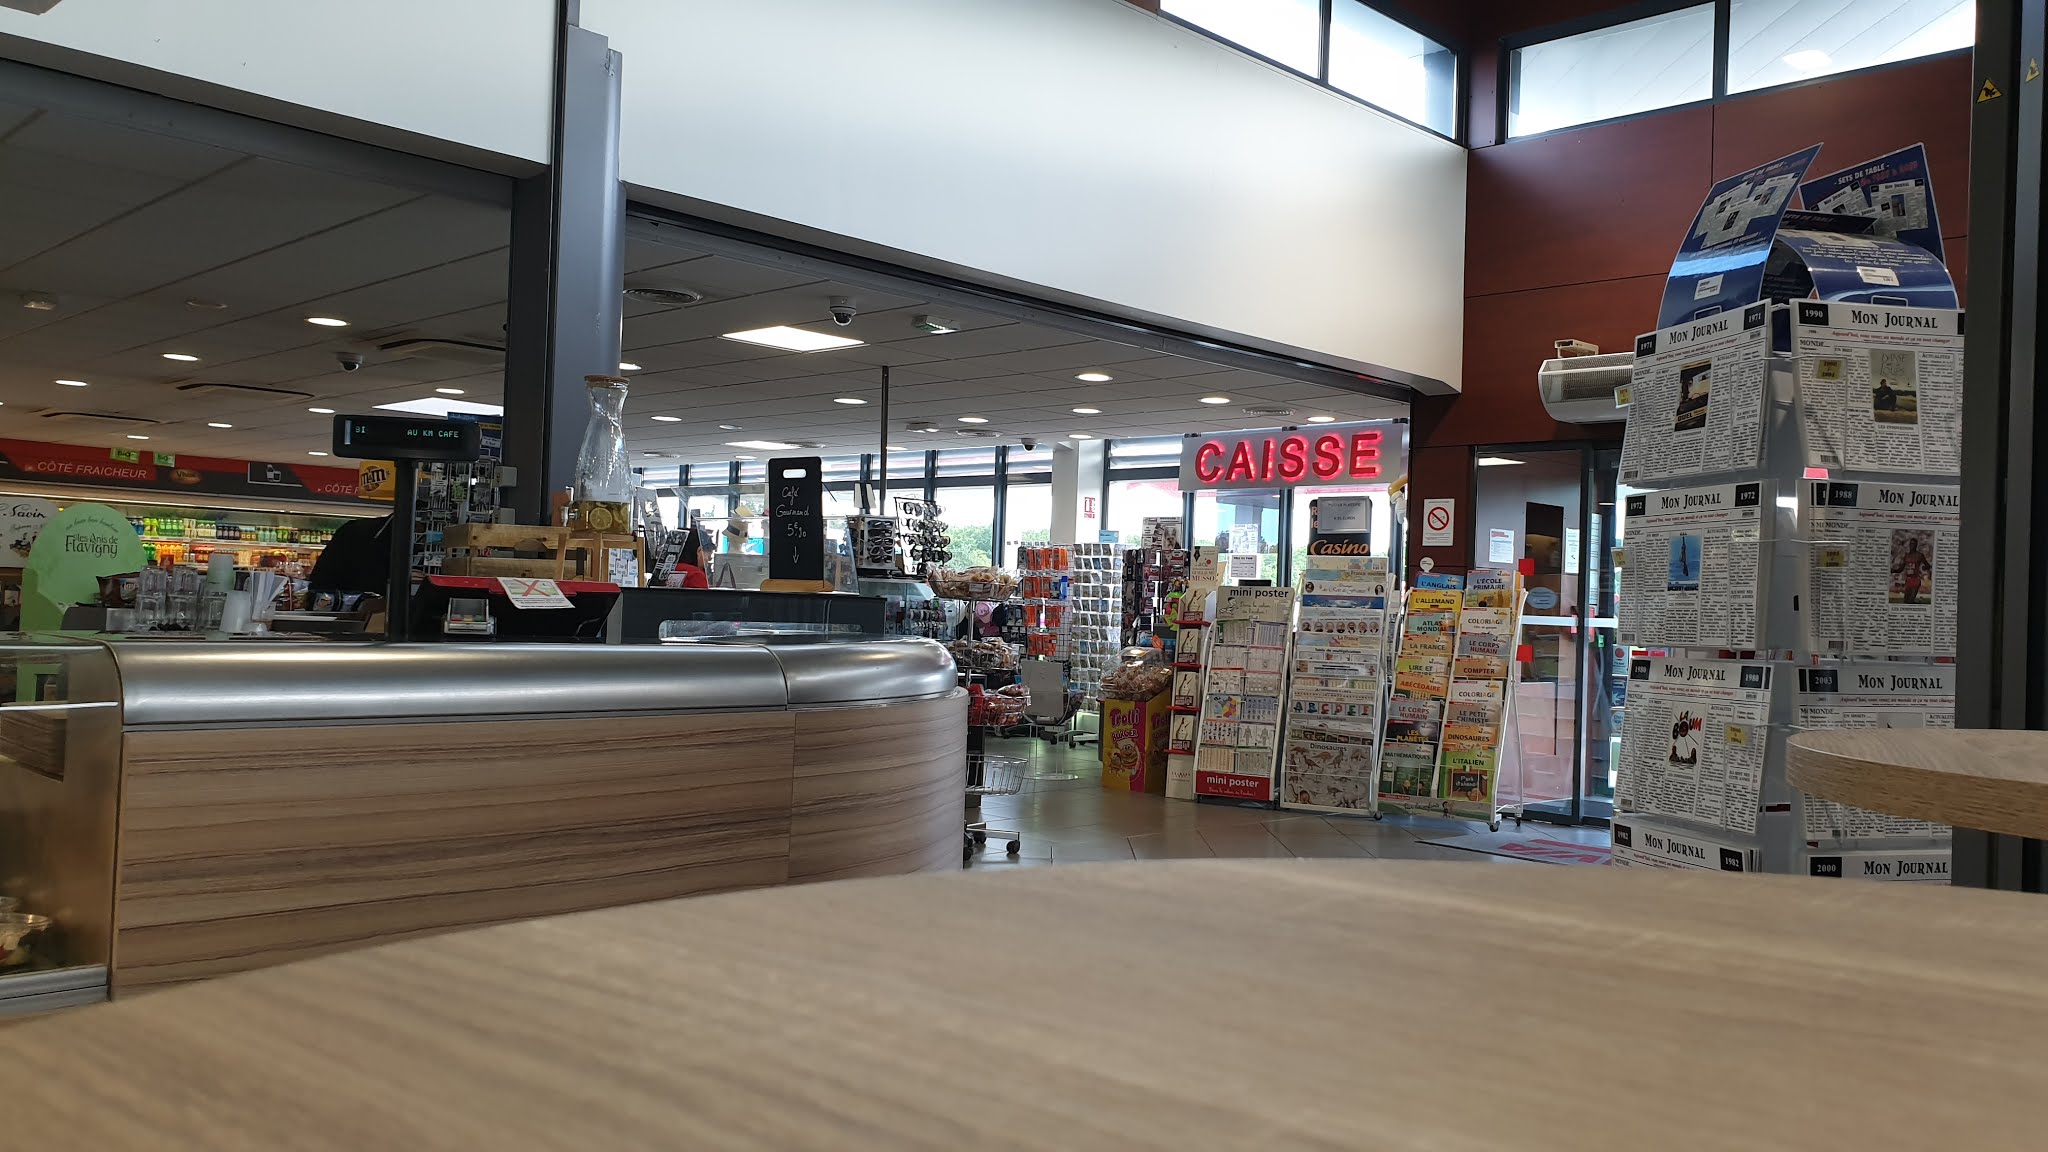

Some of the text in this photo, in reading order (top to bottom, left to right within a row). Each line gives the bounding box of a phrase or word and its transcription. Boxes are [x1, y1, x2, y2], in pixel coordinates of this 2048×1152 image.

[1838, 174, 1853, 185] SETS
[1854, 170, 1864, 179] DE
[1865, 163, 1885, 175] TABLE
[1749, 312, 1762, 324] 1971
[1805, 309, 1824, 318] 1990
[1640, 341, 1653, 350] 1971
[438, 430, 459, 438] CAFE
[1194, 433, 1380, 482] CAISSE
[37, 460, 147, 479] CÔTÉ FRAICHEUR
[782, 486, 799, 505] Café
[1740, 491, 1755, 500] 1972
[1835, 490, 1852, 499] 1988
[1630, 502, 1642, 510] 1972
[776, 504, 810, 518] Gourmand
[65, 535, 118, 558] Flavigny
[1310, 539, 1369, 555] Casino
[1421, 581, 1457, 590] L'ANGLAIS
[1230, 588, 1289, 598] mini poster
[1415, 597, 1455, 605] L'ALLEMAND
[1420, 643, 1445, 651] FRANCE
[1478, 641, 1500, 649] CORPS
[1470, 646, 1498, 655] HUMAIN
[1745, 673, 1759, 682] 1980
[1815, 676, 1833, 685] 2003
[1110, 708, 1140, 726] Trolli
[1400, 712, 1428, 720] HUMAIN
[1457, 716, 1489, 724] CHIMISTE
[1679, 710, 1689, 721] LA
[1448, 733, 1490, 742] DINOSAURES
[1310, 743, 1347, 752] Dinosaures
[1452, 758, 1484, 766] L'ITALIEN
[1207, 775, 1259, 788] mini poster
[1725, 857, 1739, 868] 1982
[1817, 864, 1836, 873] 2000
